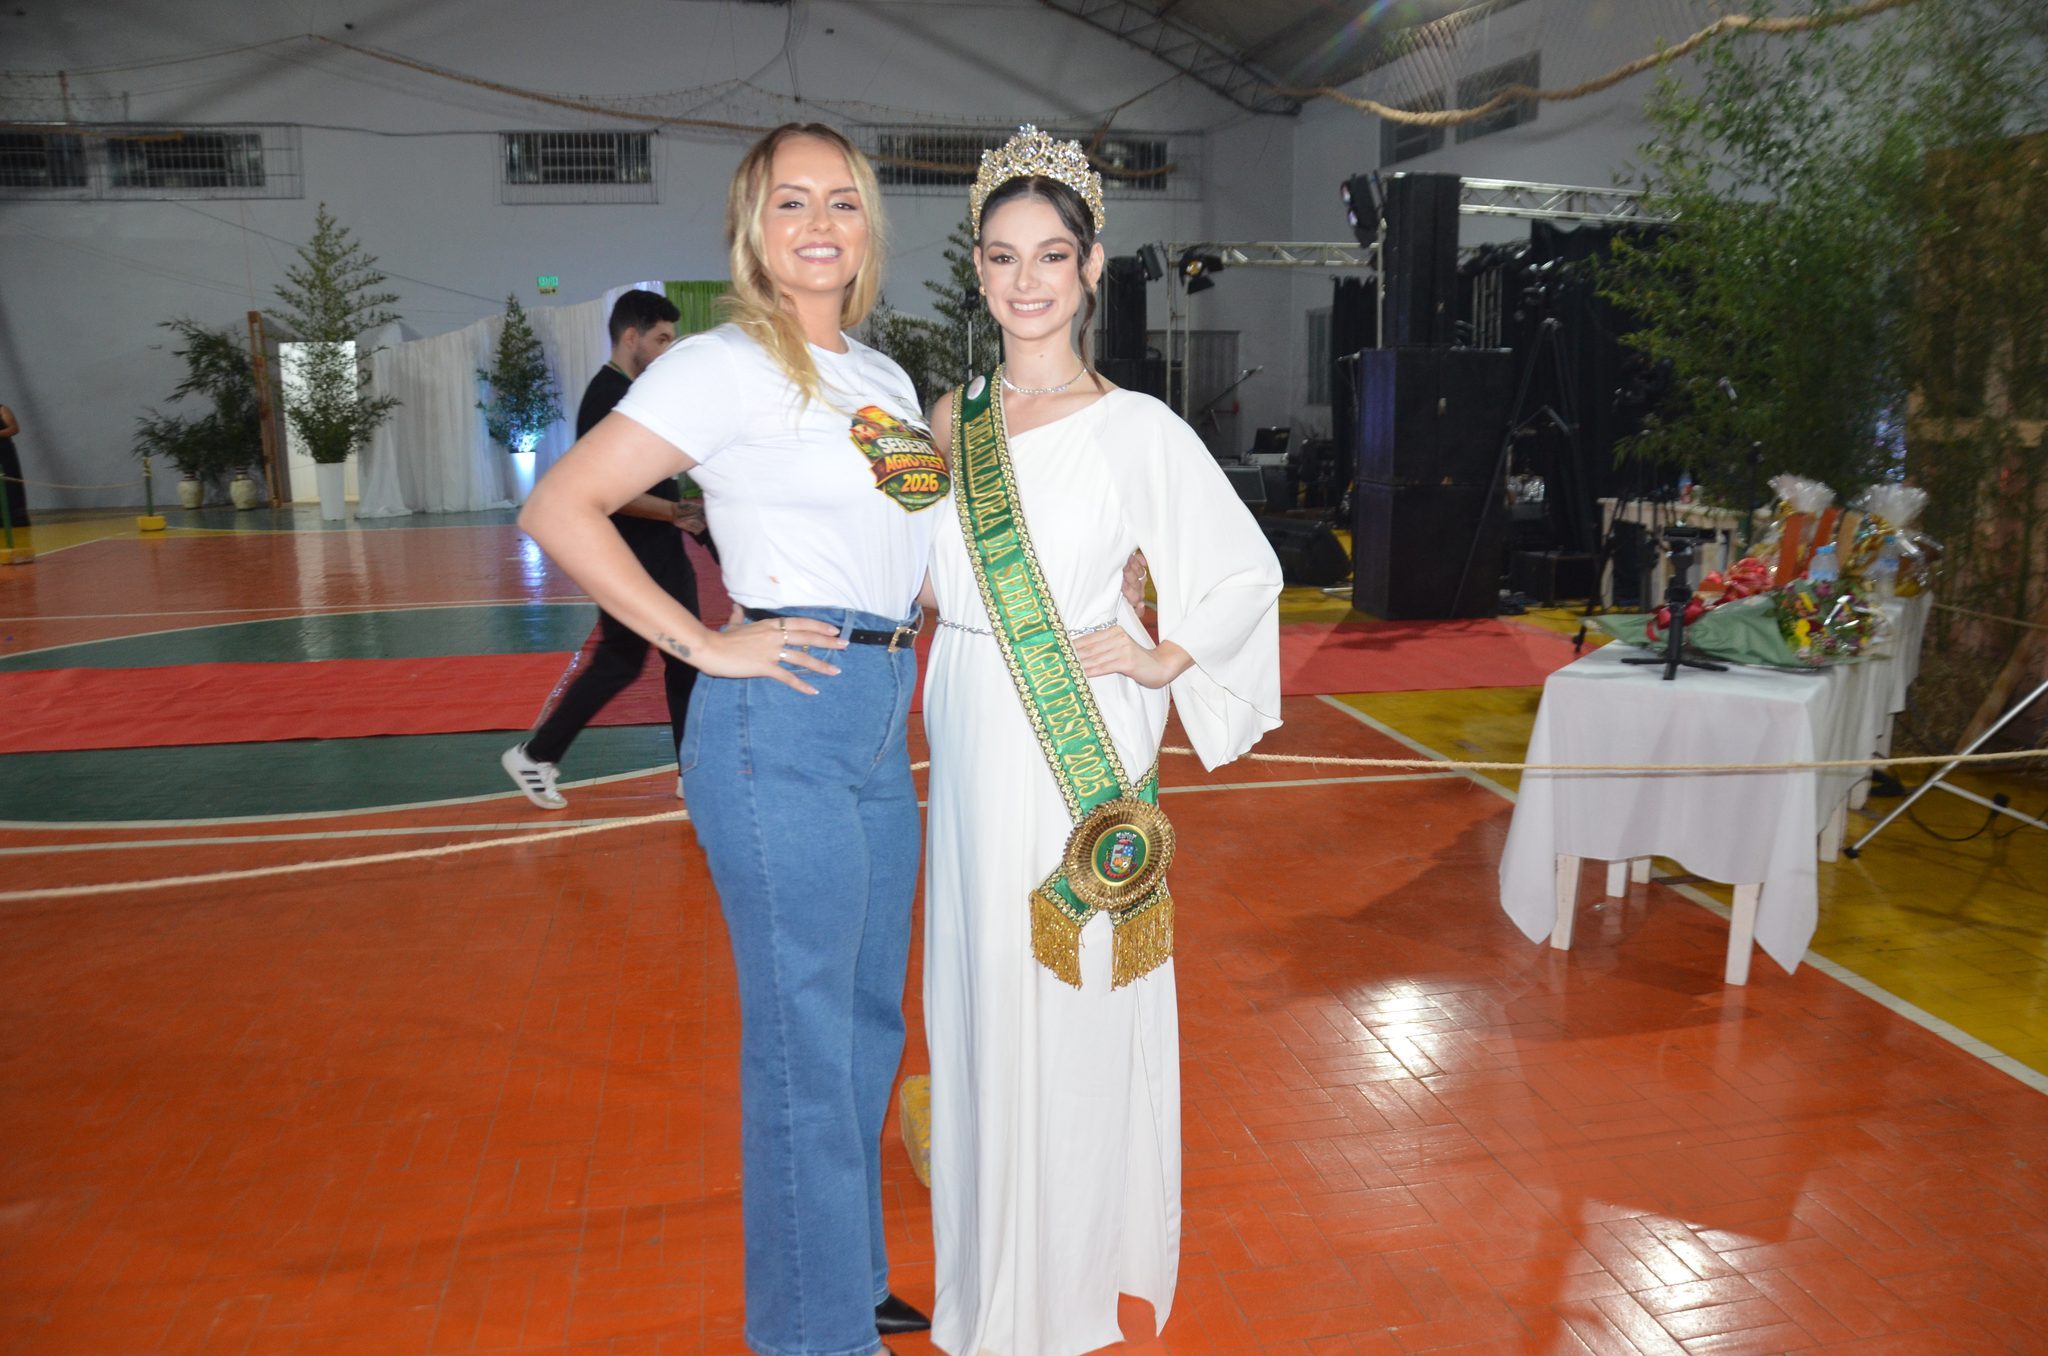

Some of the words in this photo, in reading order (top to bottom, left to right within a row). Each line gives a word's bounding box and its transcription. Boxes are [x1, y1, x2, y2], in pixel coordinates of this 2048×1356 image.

[901, 473, 940, 493] 2026
[964, 407, 1010, 534] EMBAIXADORA
[982, 528, 1017, 565] DA
[991, 562, 1048, 641] SEBERI
[1063, 744, 1114, 798] 2025
